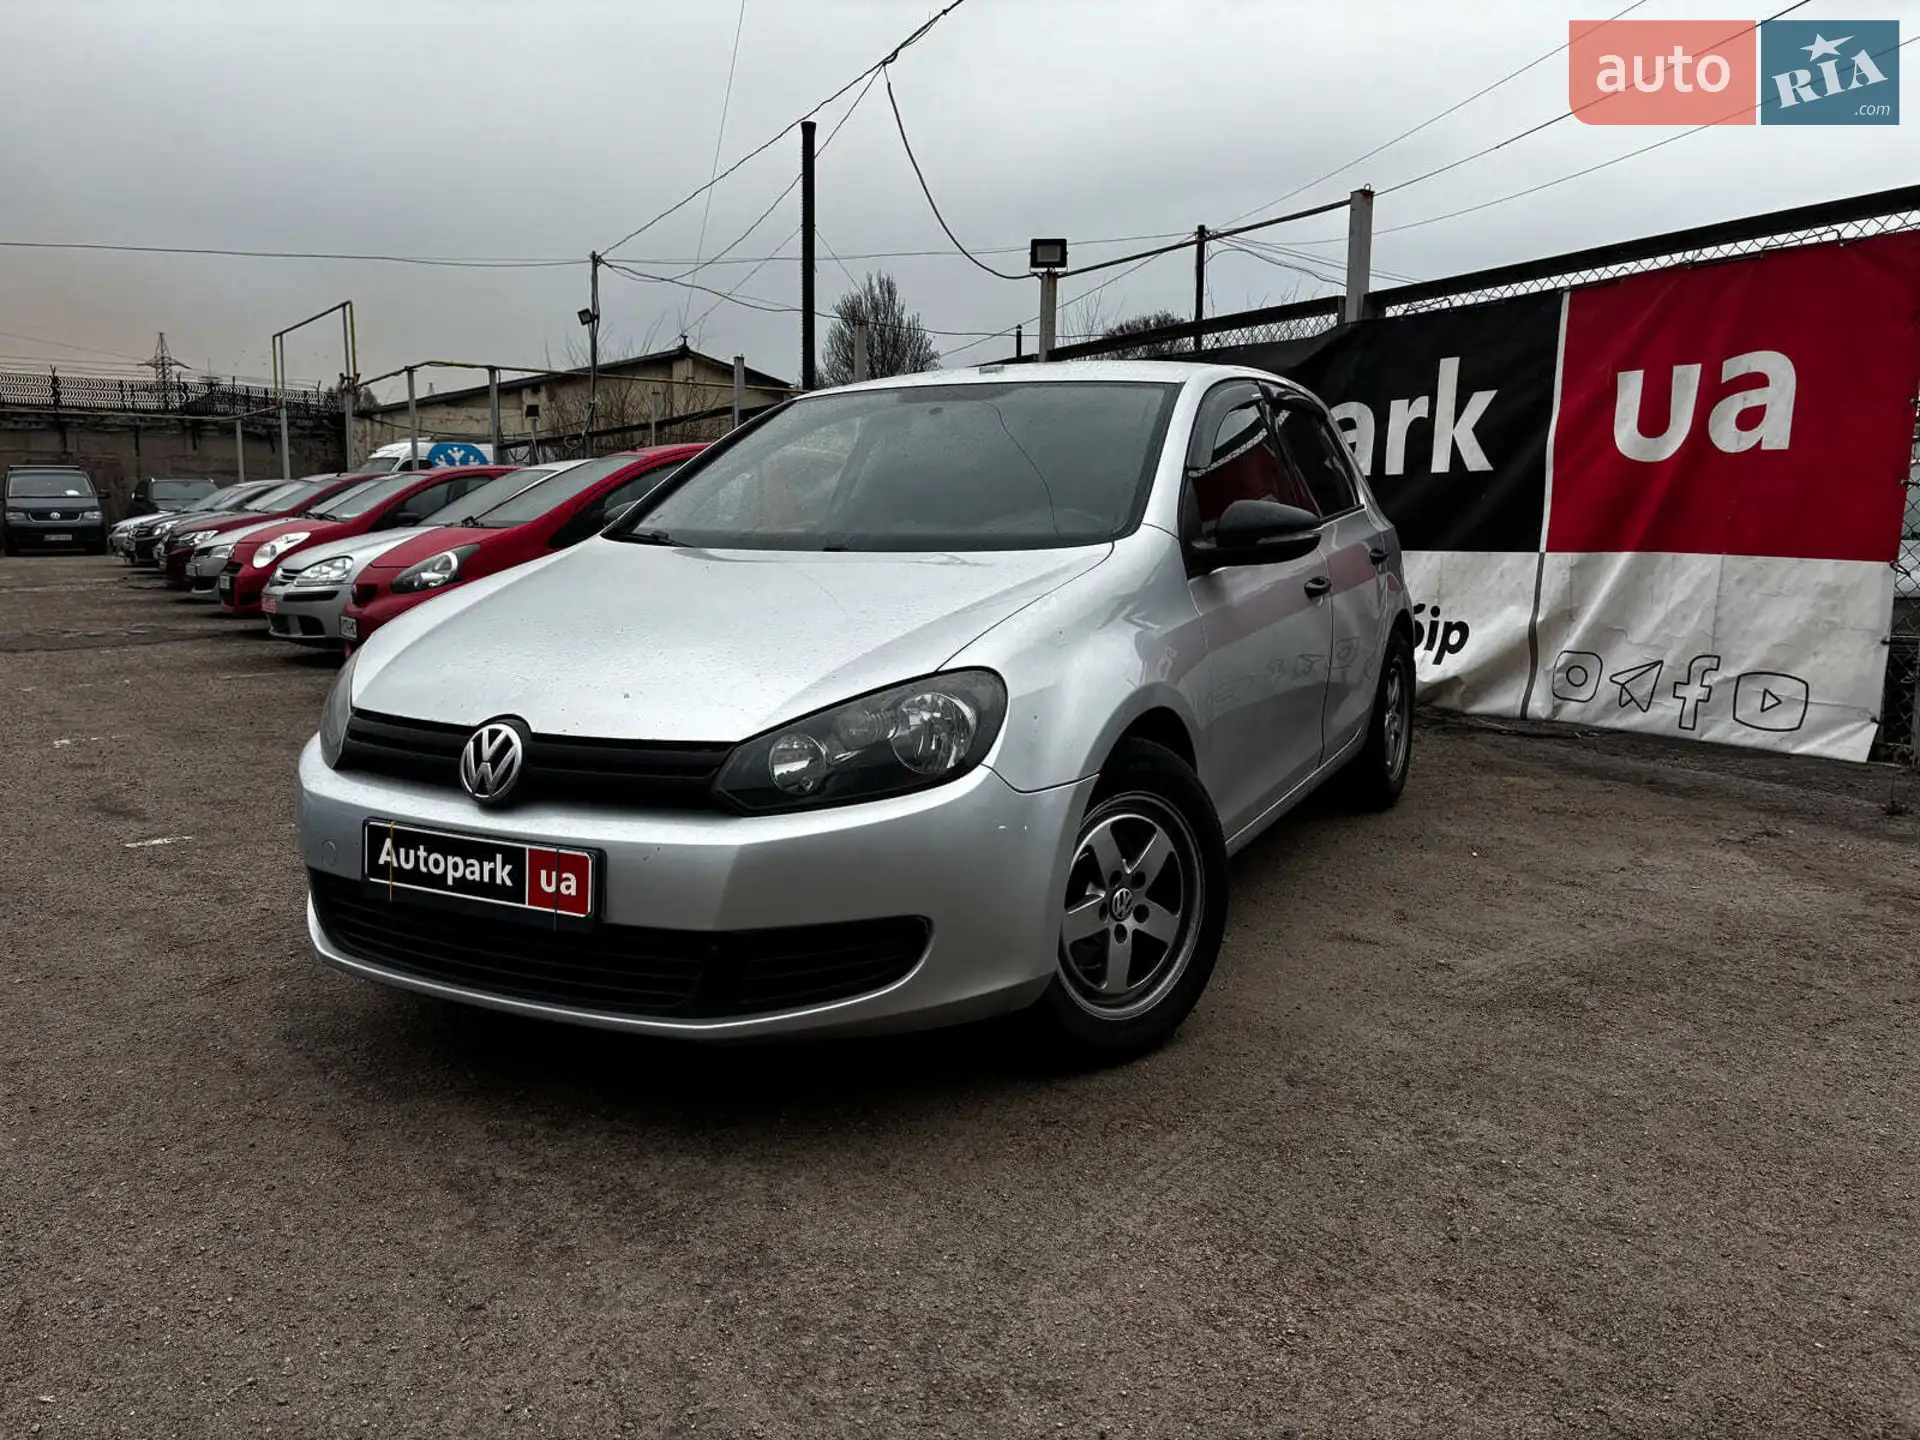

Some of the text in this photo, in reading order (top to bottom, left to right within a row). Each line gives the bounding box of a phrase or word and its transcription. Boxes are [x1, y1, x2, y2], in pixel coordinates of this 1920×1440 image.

[1613, 350, 1797, 463] ua
[377, 837, 577, 896] Autopark ua
